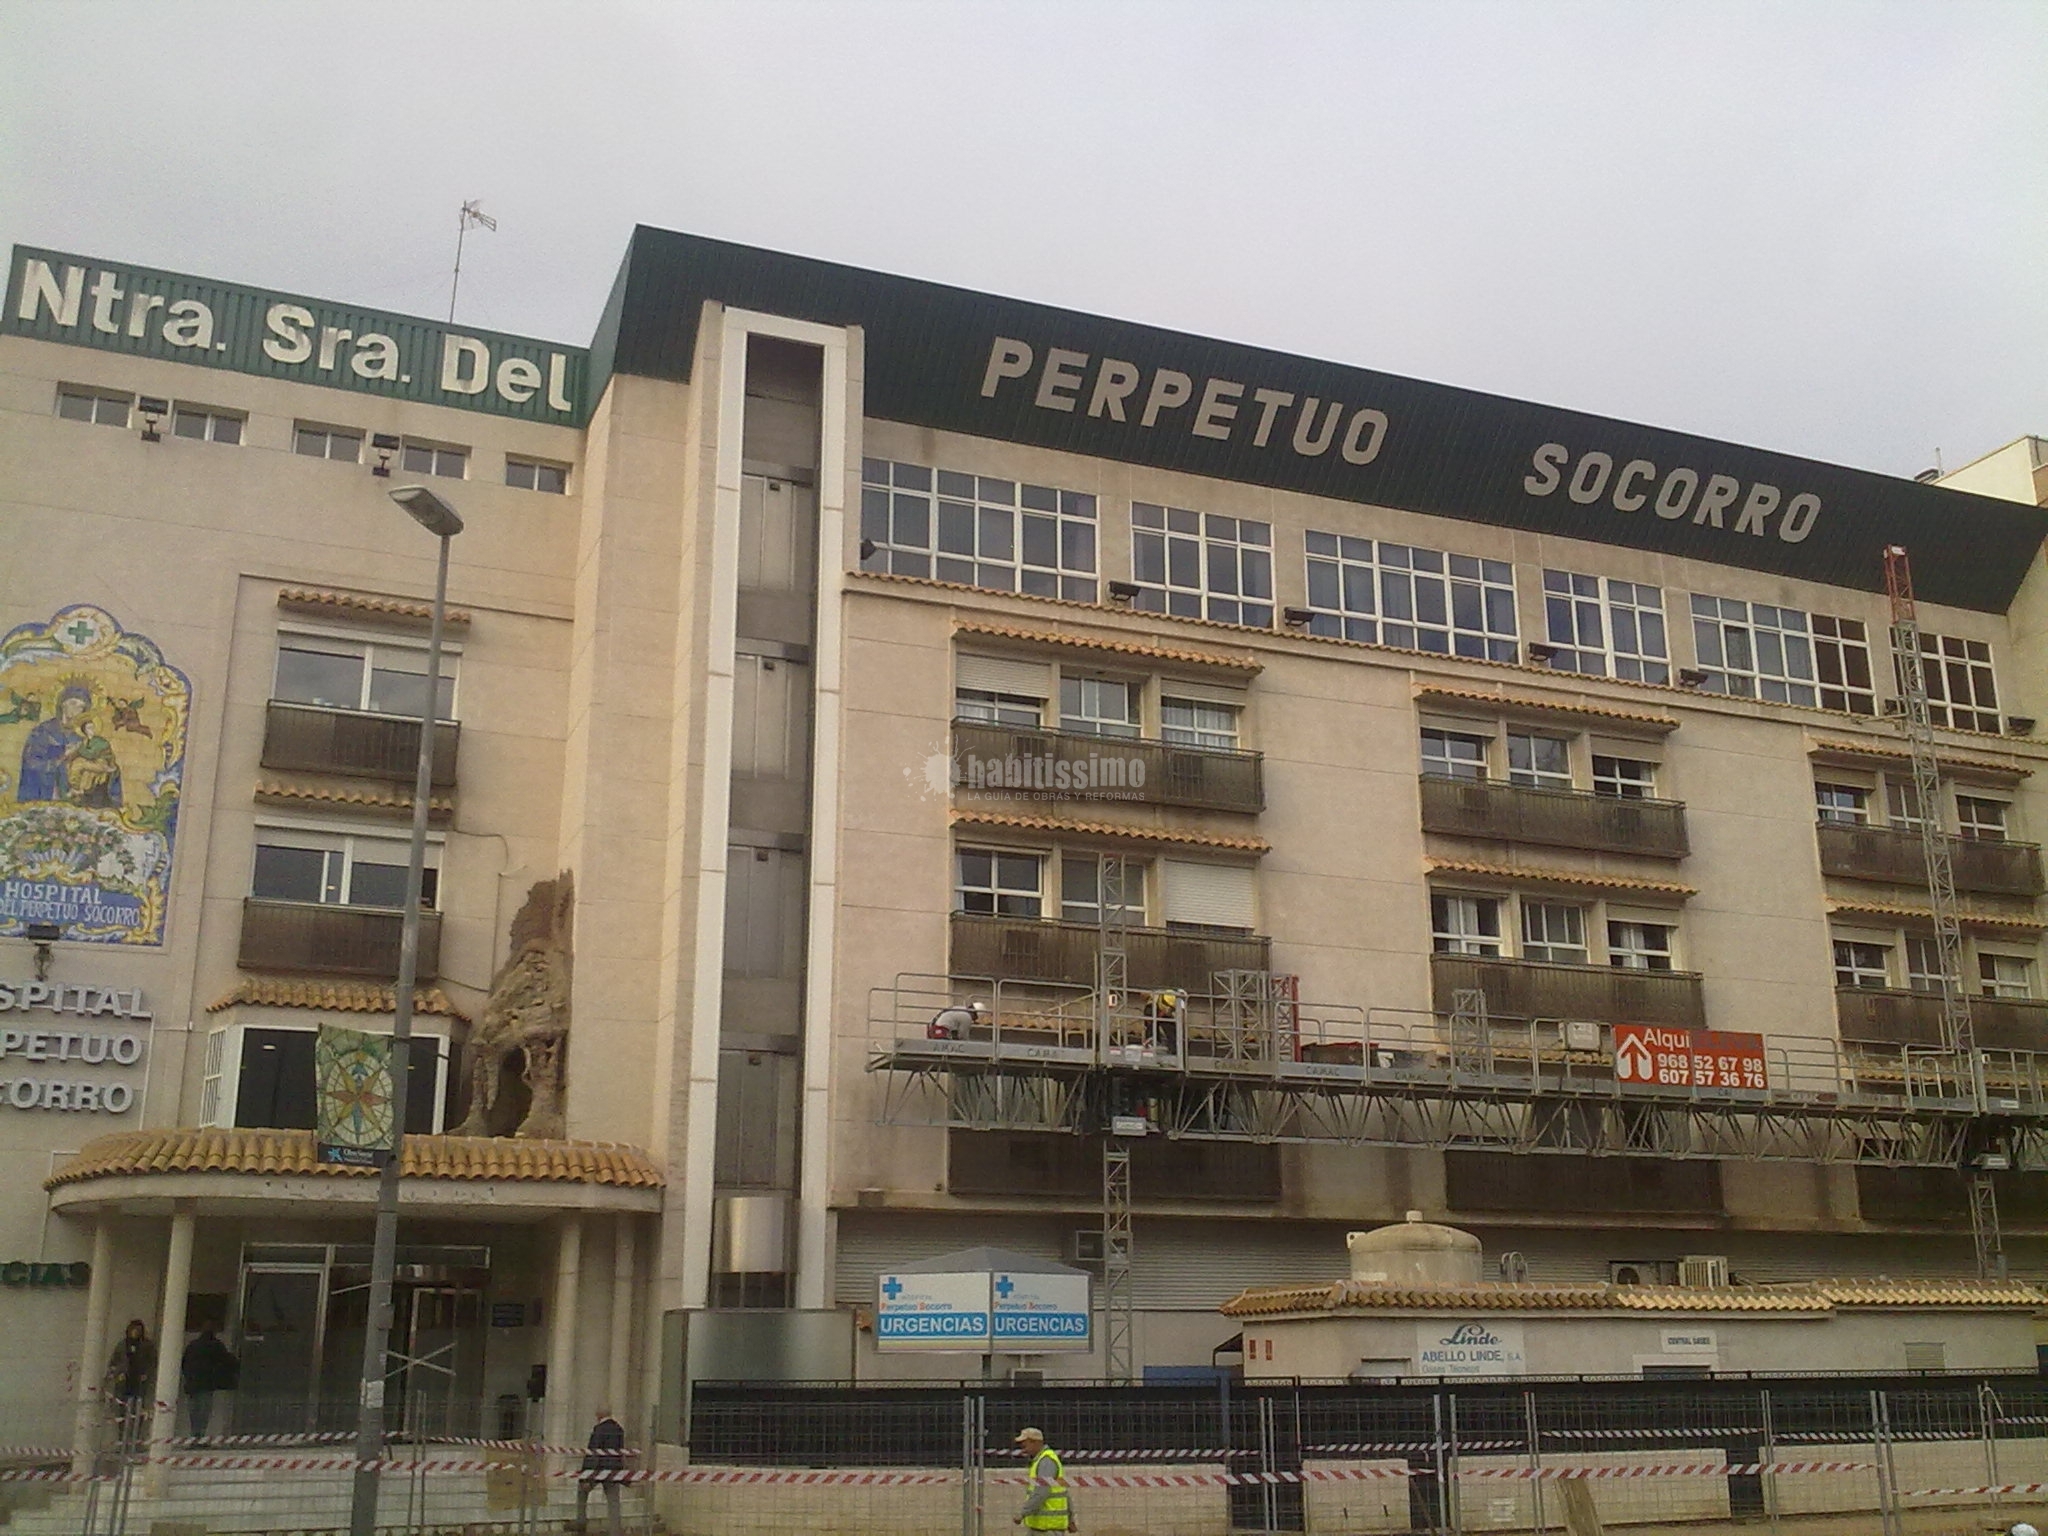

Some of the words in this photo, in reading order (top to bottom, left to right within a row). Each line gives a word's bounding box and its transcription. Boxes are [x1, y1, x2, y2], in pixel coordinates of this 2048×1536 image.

[18, 258, 227, 352] Ntra.
[262, 302, 411, 384] Sra.
[441, 333, 573, 412] Del
[980, 336, 1389, 466] PERPETUO
[1523, 442, 1822, 544] SOCORRO
[5, 881, 102, 905] HOSPITAL
[84, 904, 140, 926] SOCORRO
[1657, 1053, 1688, 1069] 968
[1694, 1055, 1714, 1070] 52
[1718, 1057, 1738, 1071] 67
[1742, 1058, 1763, 1073] 98
[1659, 1069, 1690, 1085] 607
[1695, 1071, 1714, 1086] 57
[1719, 1073, 1740, 1087] 36
[1743, 1073, 1765, 1088] 76
[0, 1077, 134, 1113] ORRO
[880, 1317, 984, 1333] URGENCIAS
[995, 1317, 1084, 1333] URGENCIAS
[1440, 1323, 1502, 1346] Linde
[1422, 1351, 1466, 1361] ABELLO
